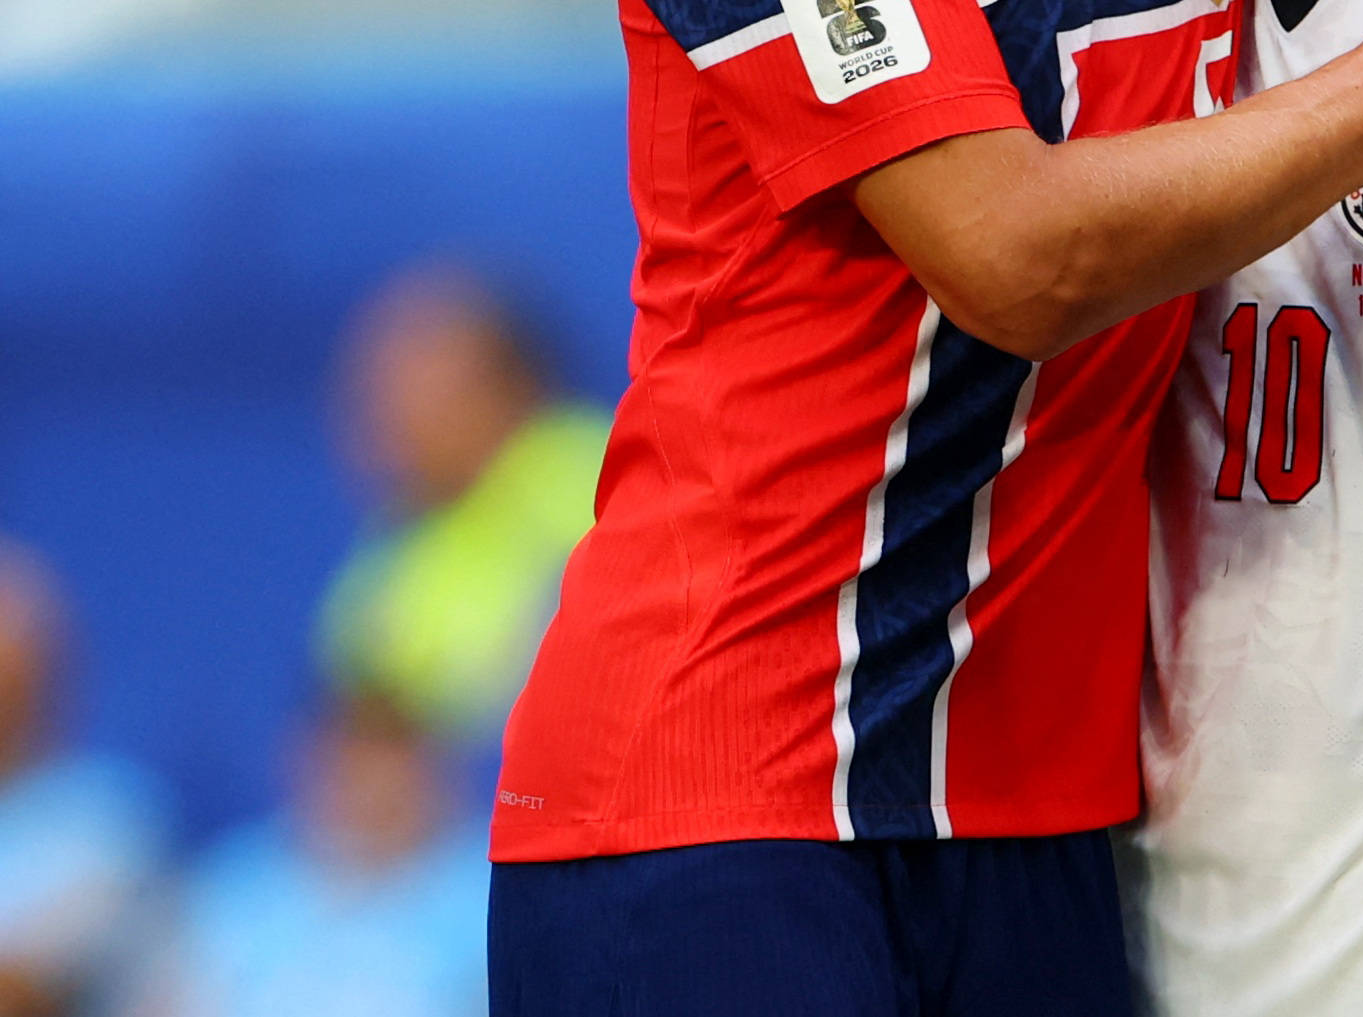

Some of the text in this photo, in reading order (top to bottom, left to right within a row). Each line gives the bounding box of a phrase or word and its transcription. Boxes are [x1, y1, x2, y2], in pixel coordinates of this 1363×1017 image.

[846, 30, 874, 47] FIFA
[838, 46, 893, 70] WORLD CUP
[842, 55, 898, 84] 2026
[1214, 302, 1331, 504] 10
